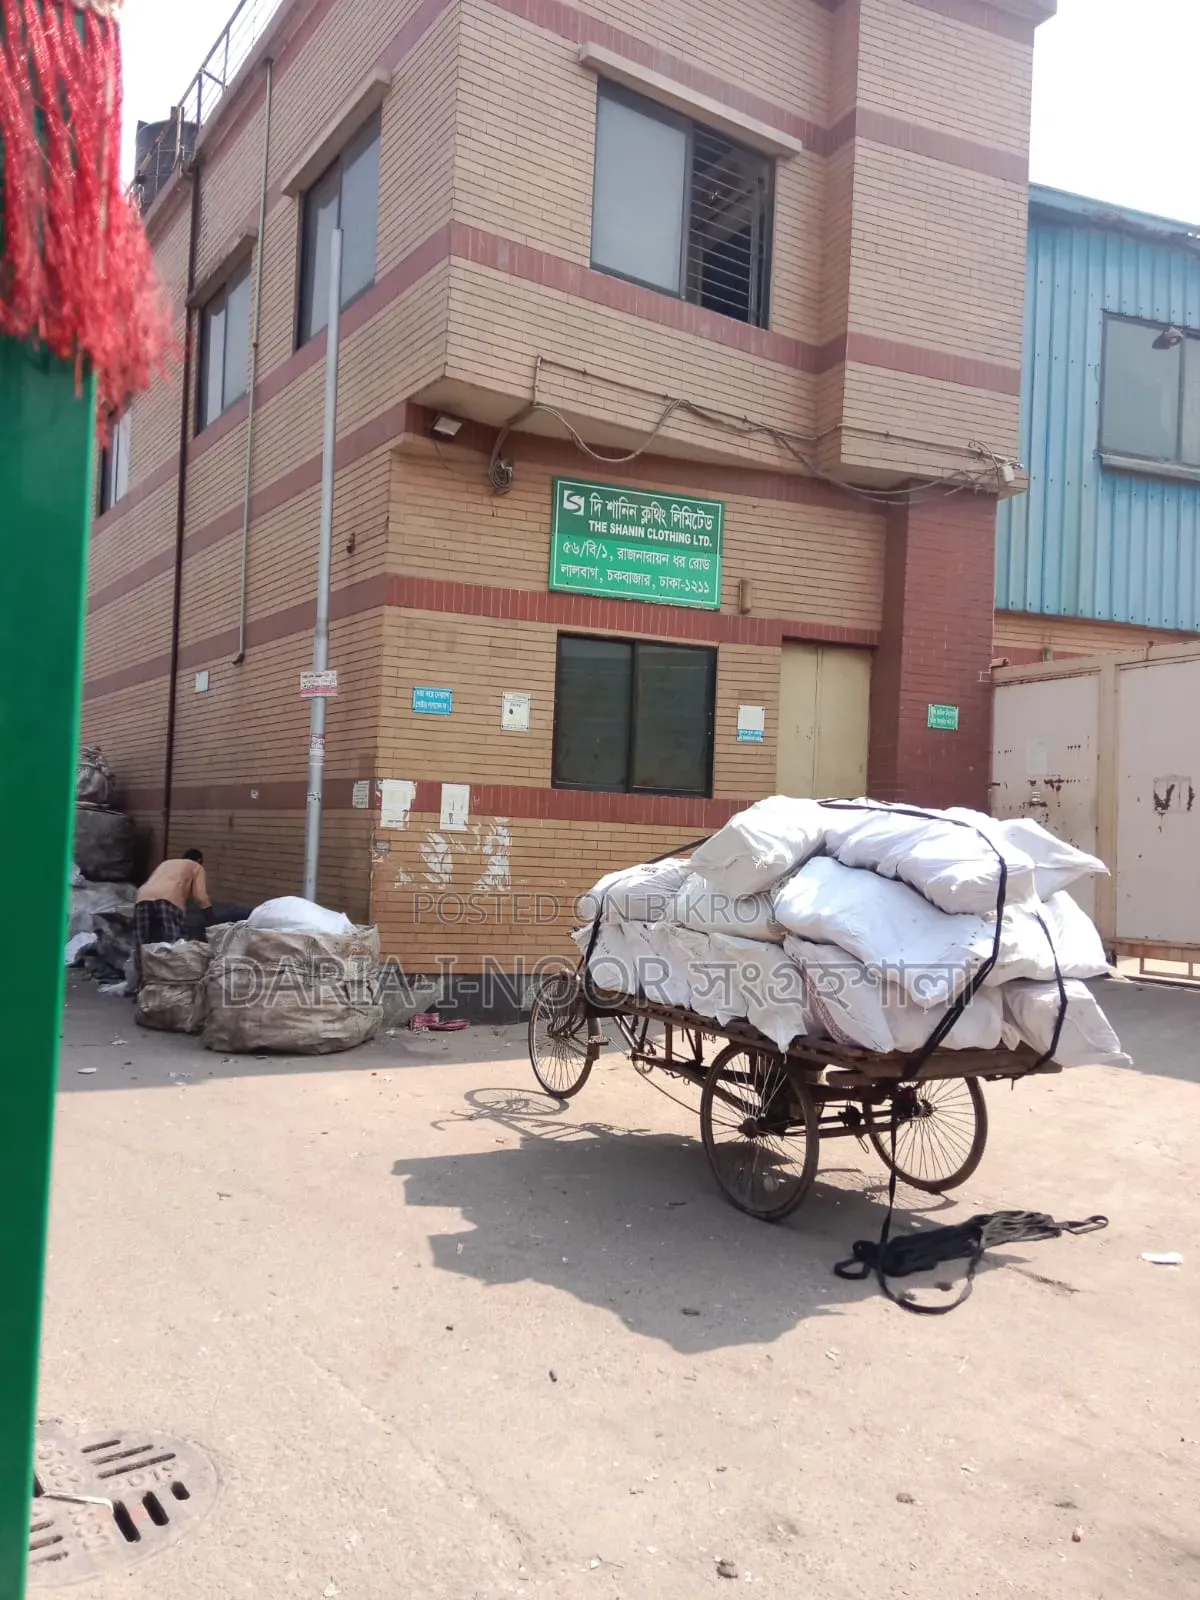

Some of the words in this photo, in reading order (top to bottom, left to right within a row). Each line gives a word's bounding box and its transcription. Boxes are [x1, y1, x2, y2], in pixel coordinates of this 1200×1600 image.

[589, 492, 602, 517] দি
[605, 496, 638, 521] শানিন
[640, 500, 667, 528] ক্লথিং
[670, 504, 714, 532] লিমিটেড
[588, 520, 607, 533] THE
[609, 522, 645, 539] SHANIN
[647, 527, 691, 545] CLOTHING
[693, 532, 713, 548] LTD.
[672, 554, 686, 569] ধর
[688, 556, 711, 571] রোড
[659, 574, 710, 595] ঢাকা-১২১১
